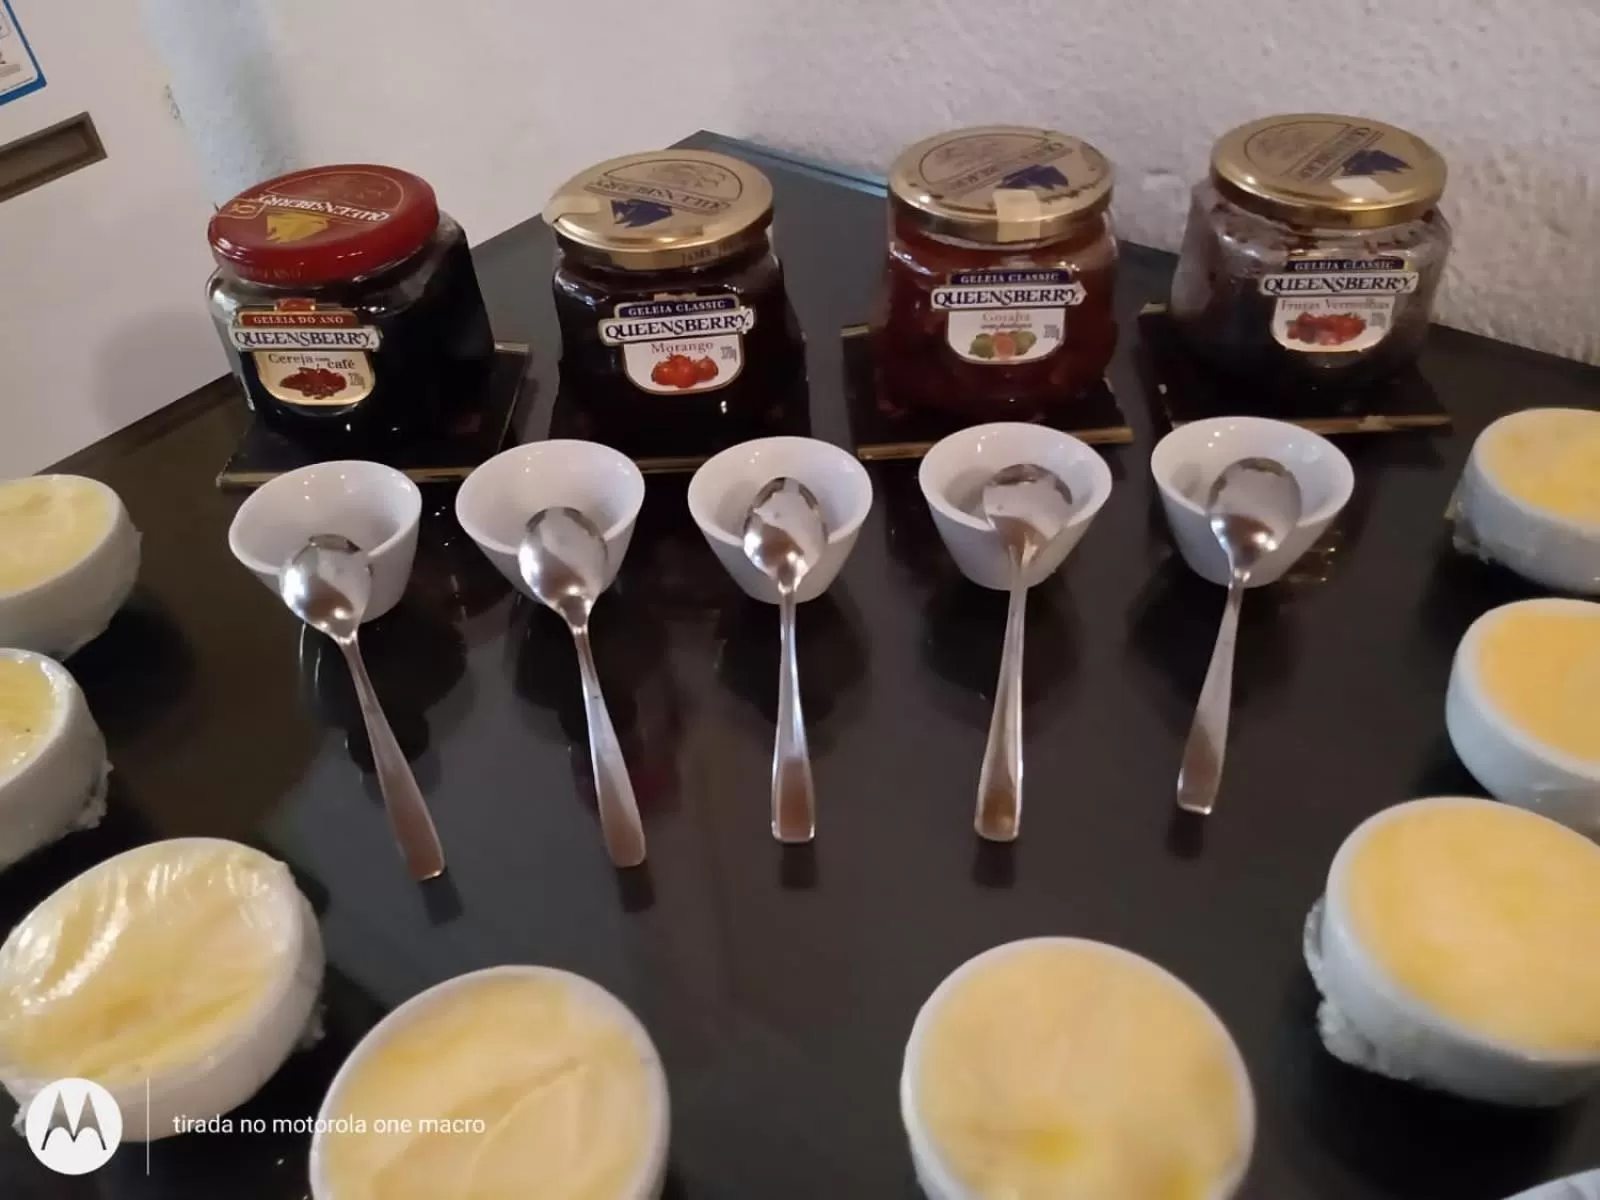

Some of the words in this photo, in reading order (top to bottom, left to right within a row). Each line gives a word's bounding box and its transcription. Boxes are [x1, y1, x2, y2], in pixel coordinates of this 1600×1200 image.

[960, 274, 1005, 284] GELEIA
[1008, 272, 1060, 283] CLASSIC
[1264, 274, 1416, 297] QUEENSBERRY
[934, 288, 1077, 307] QUEENSBERRY
[628, 306, 673, 317] GELEIA
[675, 300, 727, 313] CLASSIC
[253, 315, 296, 325] GELEIA
[299, 315, 317, 325] DO
[319, 315, 345, 325] ANO
[605, 311, 750, 341] QUEENSBERRY
[234, 331, 376, 348] QUEENSBERRY
[650, 341, 714, 355] Morango
[268, 352, 313, 367] Cereja
[327, 359, 356, 370] café
